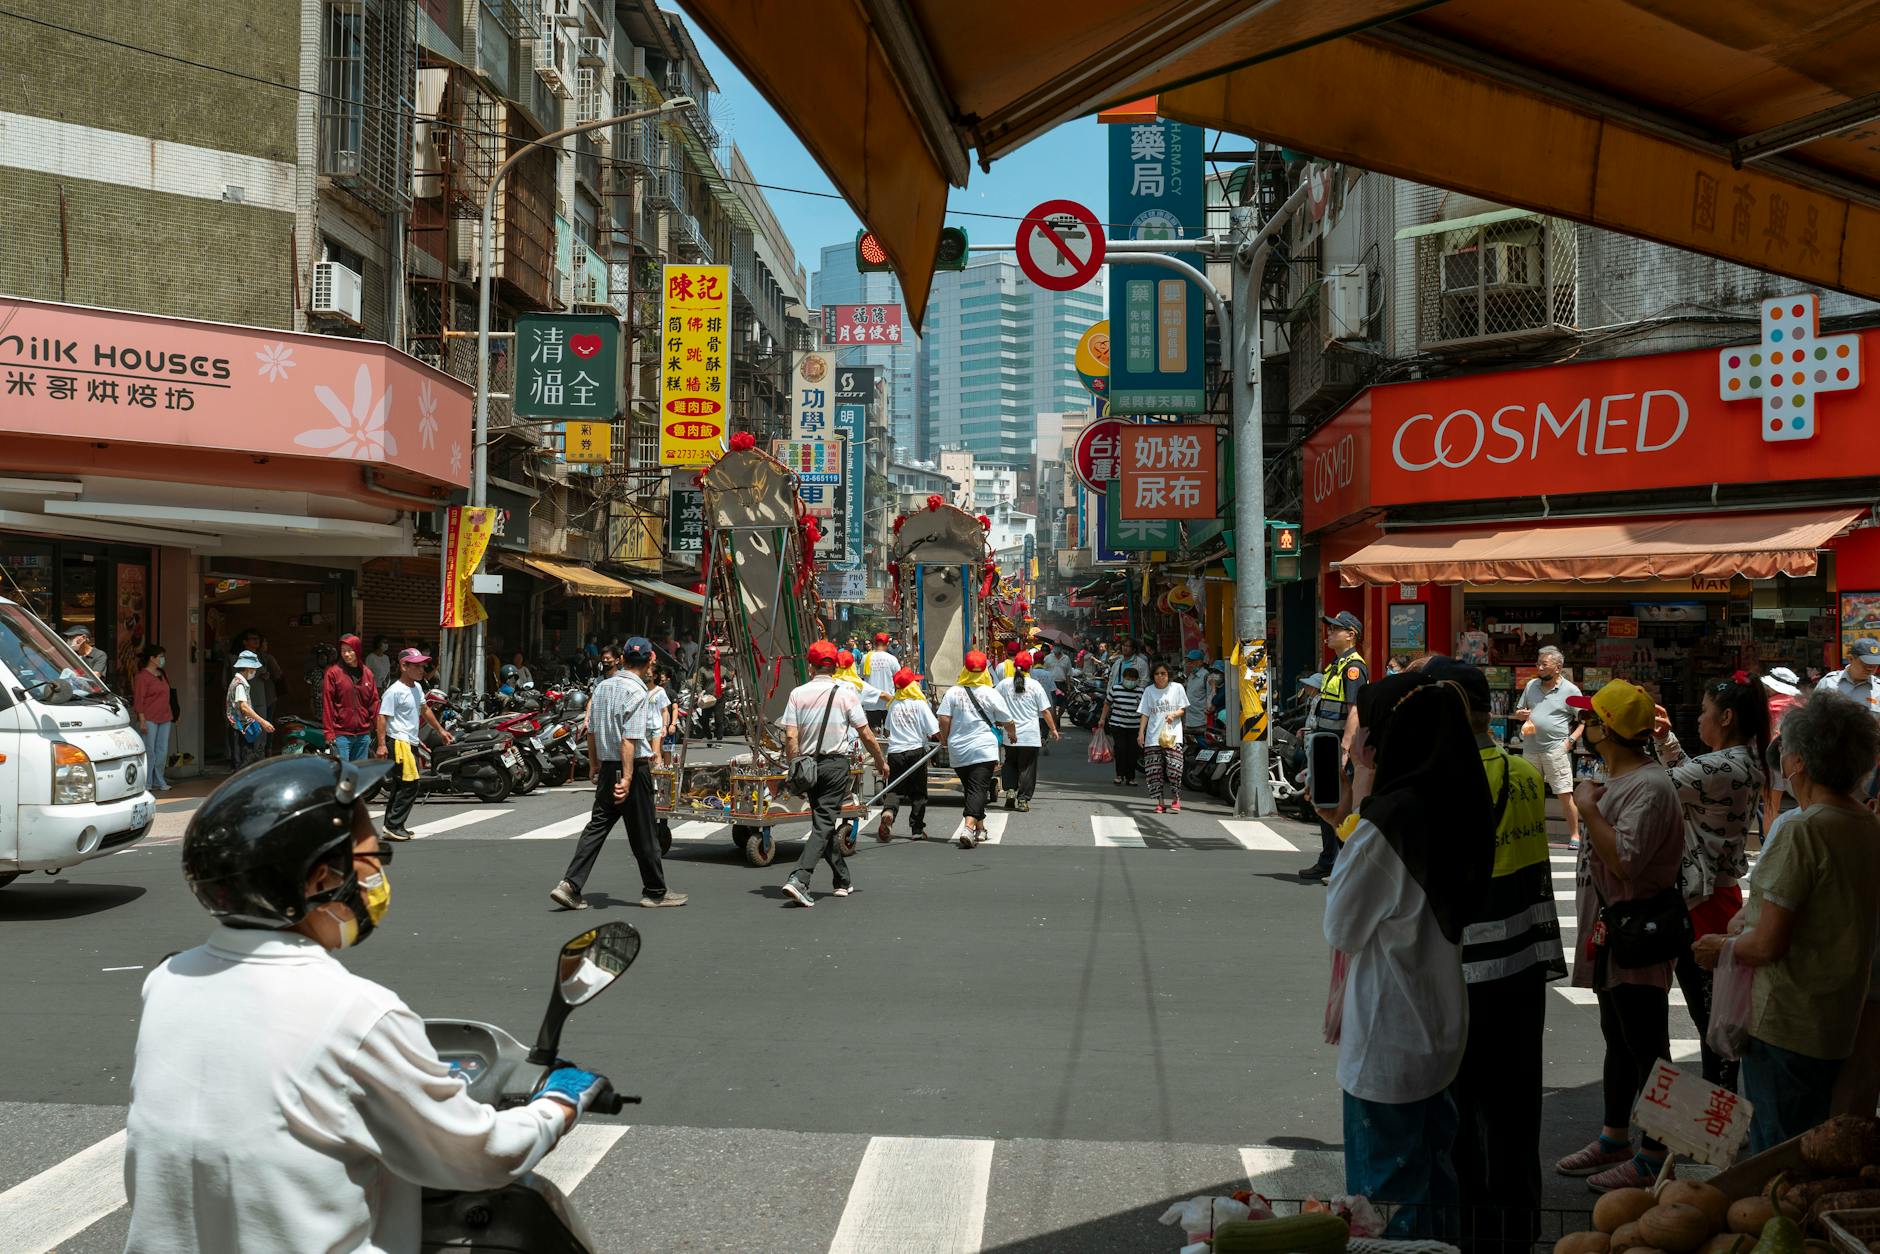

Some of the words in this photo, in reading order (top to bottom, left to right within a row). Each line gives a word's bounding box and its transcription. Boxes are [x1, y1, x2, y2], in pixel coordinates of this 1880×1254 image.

[1130, 125, 1166, 197] 藥局
[1170, 122, 1185, 196] HARMACY
[669, 273, 723, 302] 陳記
[839, 324, 901, 341] 月台便當
[852, 306, 888, 324] 福隆
[530, 327, 564, 364] 清
[666, 316, 683, 392] 筒仔米糕
[705, 316, 722, 392] 排骨酥湯
[6, 371, 196, 411] 米哥烘焙坊
[530, 368, 600, 407] 福全
[674, 401, 714, 413] 雞肉飯
[673, 424, 713, 437] 魯肉飯
[1391, 388, 1689, 472] COSMED
[1135, 435, 1201, 469] 奶粉
[1313, 433, 1354, 504] COSMED
[1135, 475, 1201, 509] 尿布
[1645, 1065, 1738, 1138] 豆薯
